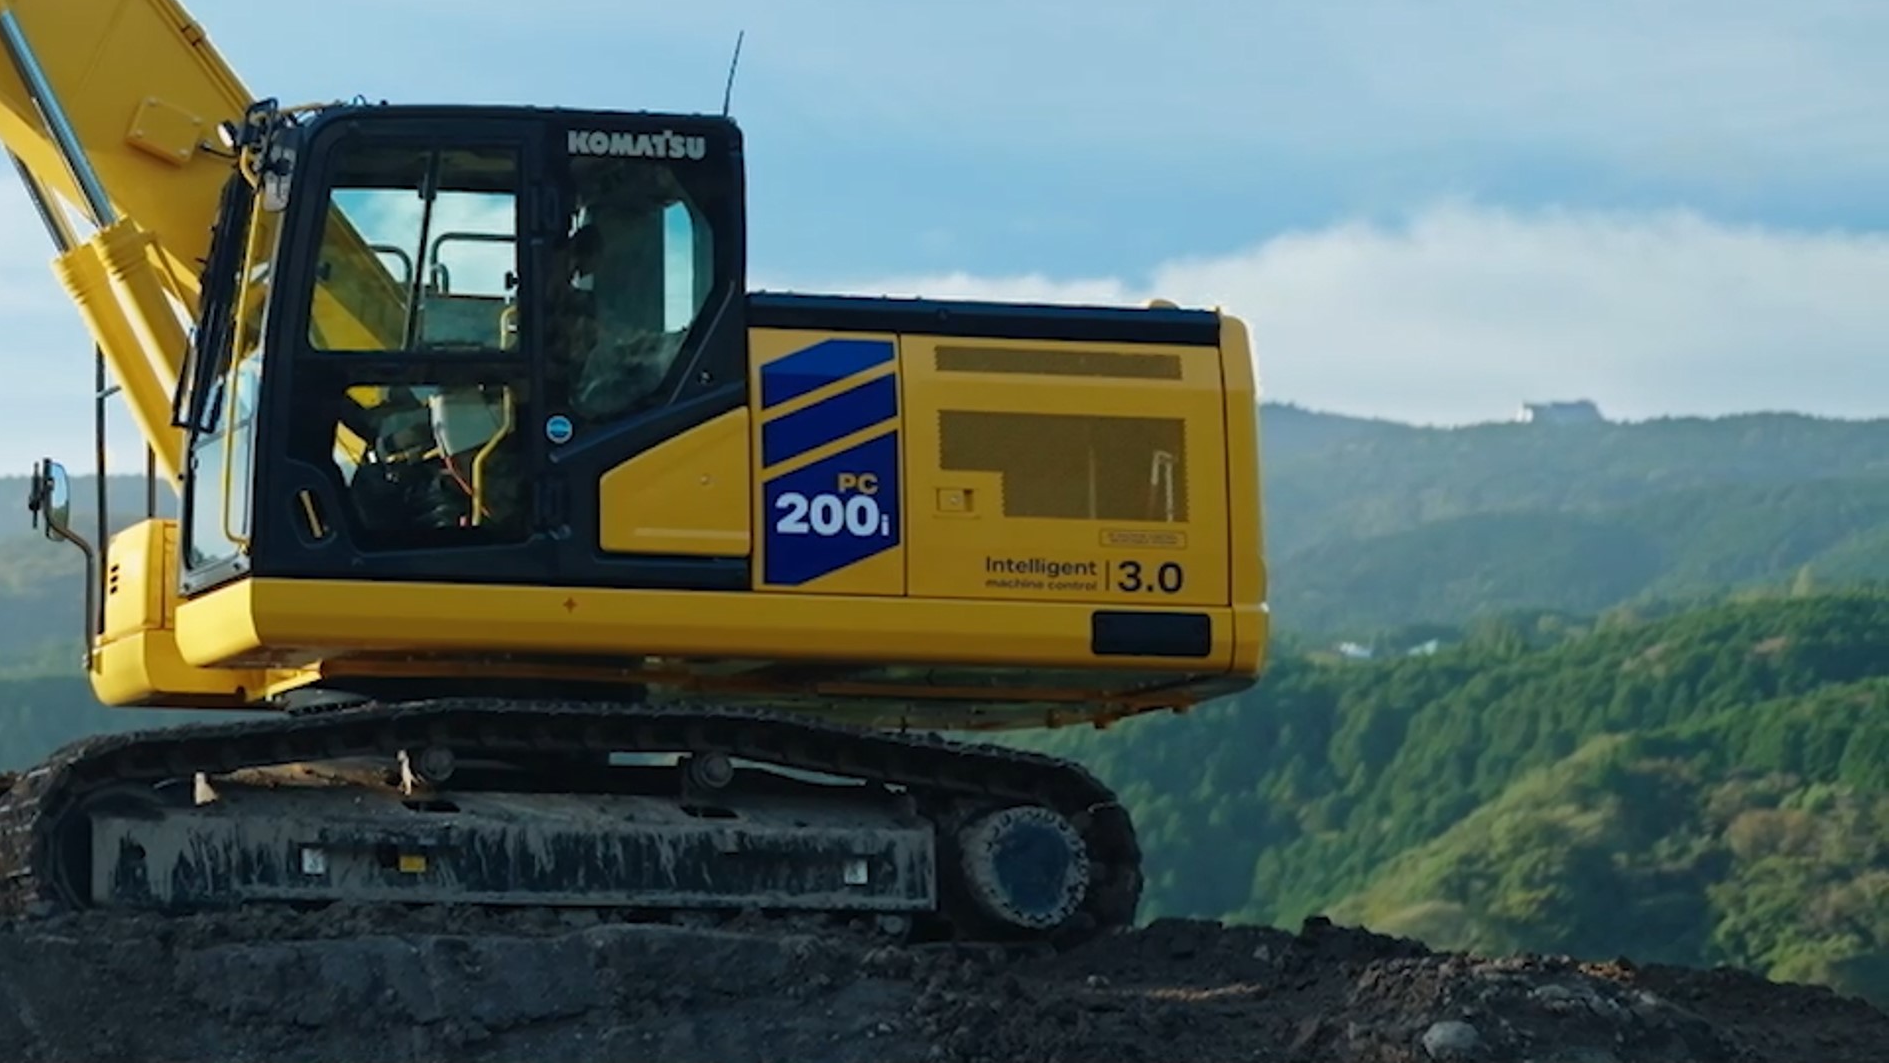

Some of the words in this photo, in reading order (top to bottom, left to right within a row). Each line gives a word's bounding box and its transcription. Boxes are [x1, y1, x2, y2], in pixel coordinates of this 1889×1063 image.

[567, 129, 706, 160] KOMATSU
[837, 472, 879, 495] PC
[774, 492, 890, 537] 200i
[985, 556, 1098, 578] Intelligent
[1117, 560, 1184, 594] 3.0
